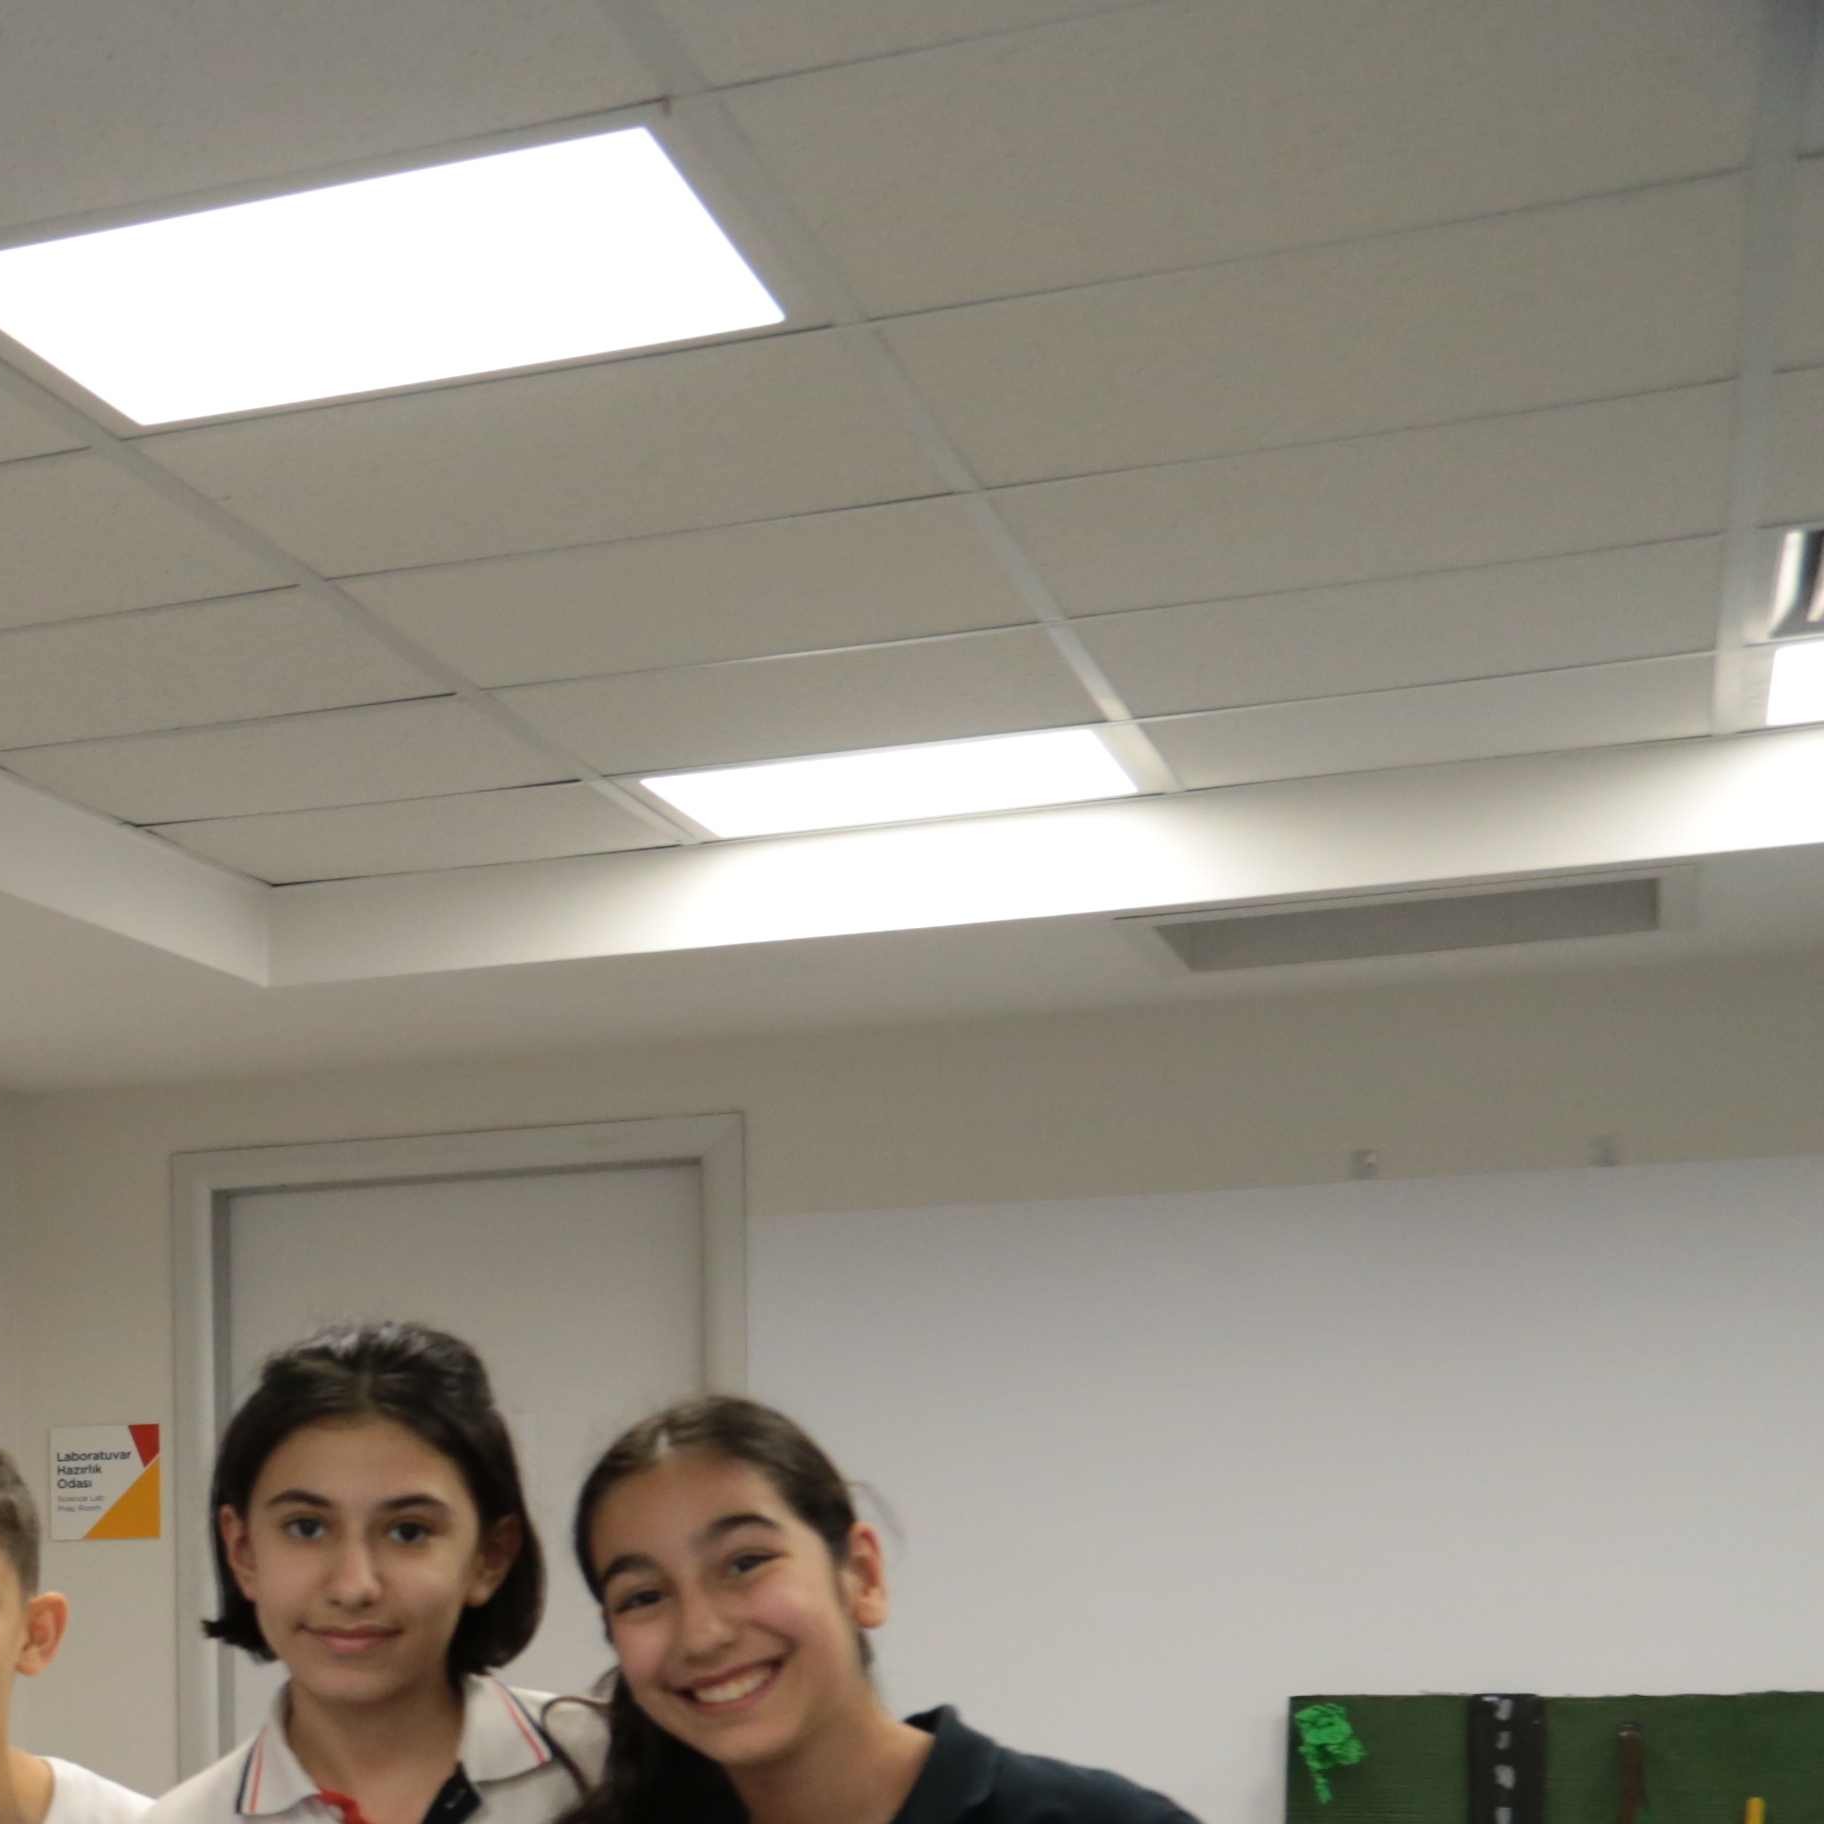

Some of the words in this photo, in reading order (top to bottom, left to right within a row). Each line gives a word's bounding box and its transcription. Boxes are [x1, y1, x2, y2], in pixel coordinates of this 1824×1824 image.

[57, 1451, 131, 1461] Laboratuvar
[57, 1464, 102, 1475] Hazırlık
[57, 1478, 92, 1489] Odası
